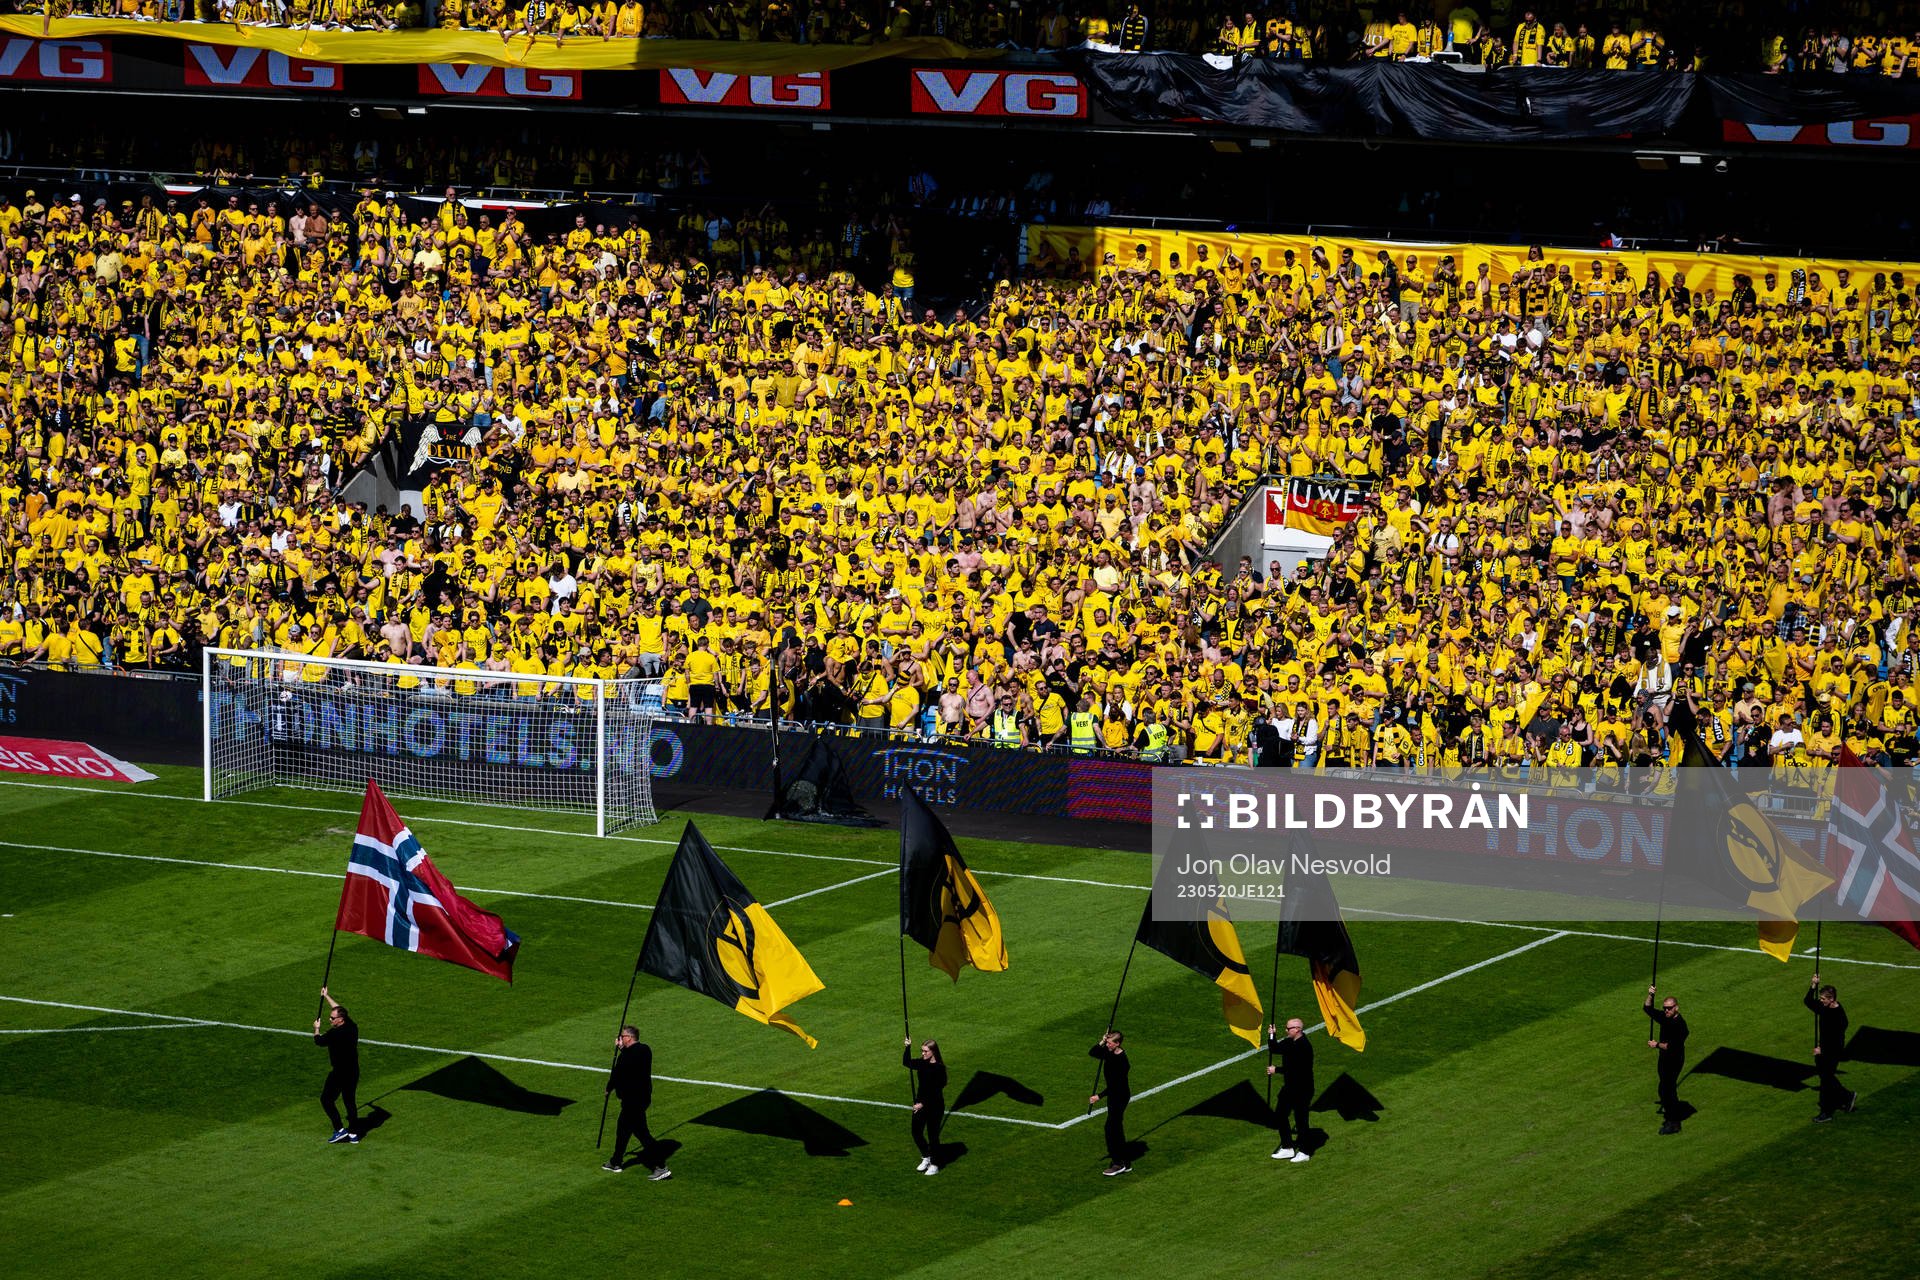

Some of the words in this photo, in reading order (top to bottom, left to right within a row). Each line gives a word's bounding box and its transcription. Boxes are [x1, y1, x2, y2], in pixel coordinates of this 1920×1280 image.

[187, 44, 335, 88] VG
[427, 63, 573, 97] VG
[667, 68, 823, 108] VG
[915, 71, 1079, 116] VG
[1292, 479, 1361, 514] UWE
[0, 745, 114, 777] els.no
[872, 748, 968, 784] THON
